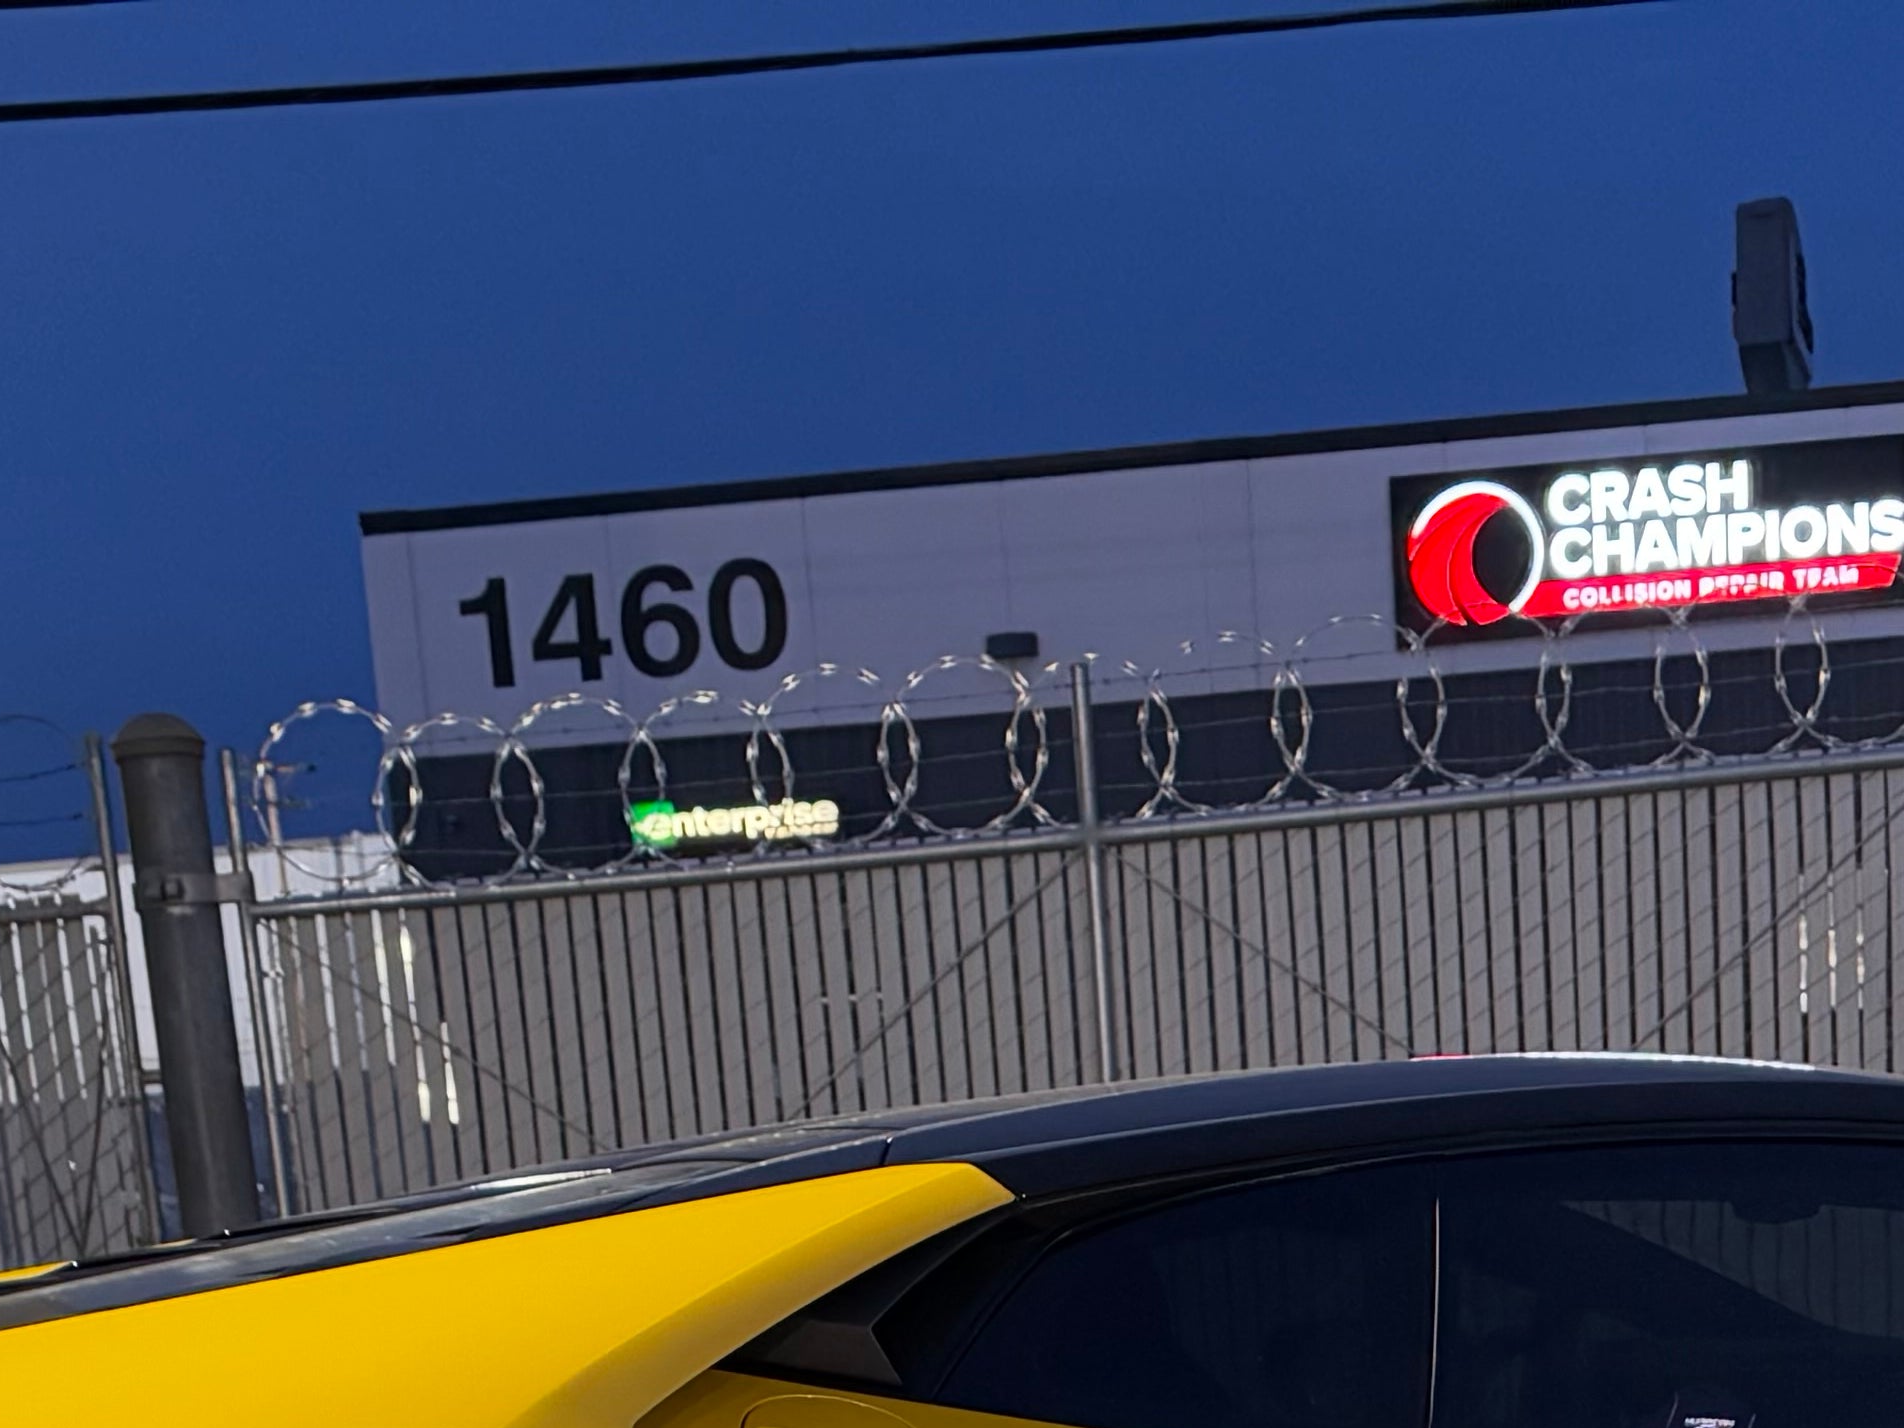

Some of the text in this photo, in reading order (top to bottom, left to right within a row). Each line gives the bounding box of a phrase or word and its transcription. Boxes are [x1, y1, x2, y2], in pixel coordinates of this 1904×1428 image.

[1547, 458, 1751, 524] CRASH
[458, 556, 788, 688] 1460
[1562, 579, 1692, 609] COLLISION
